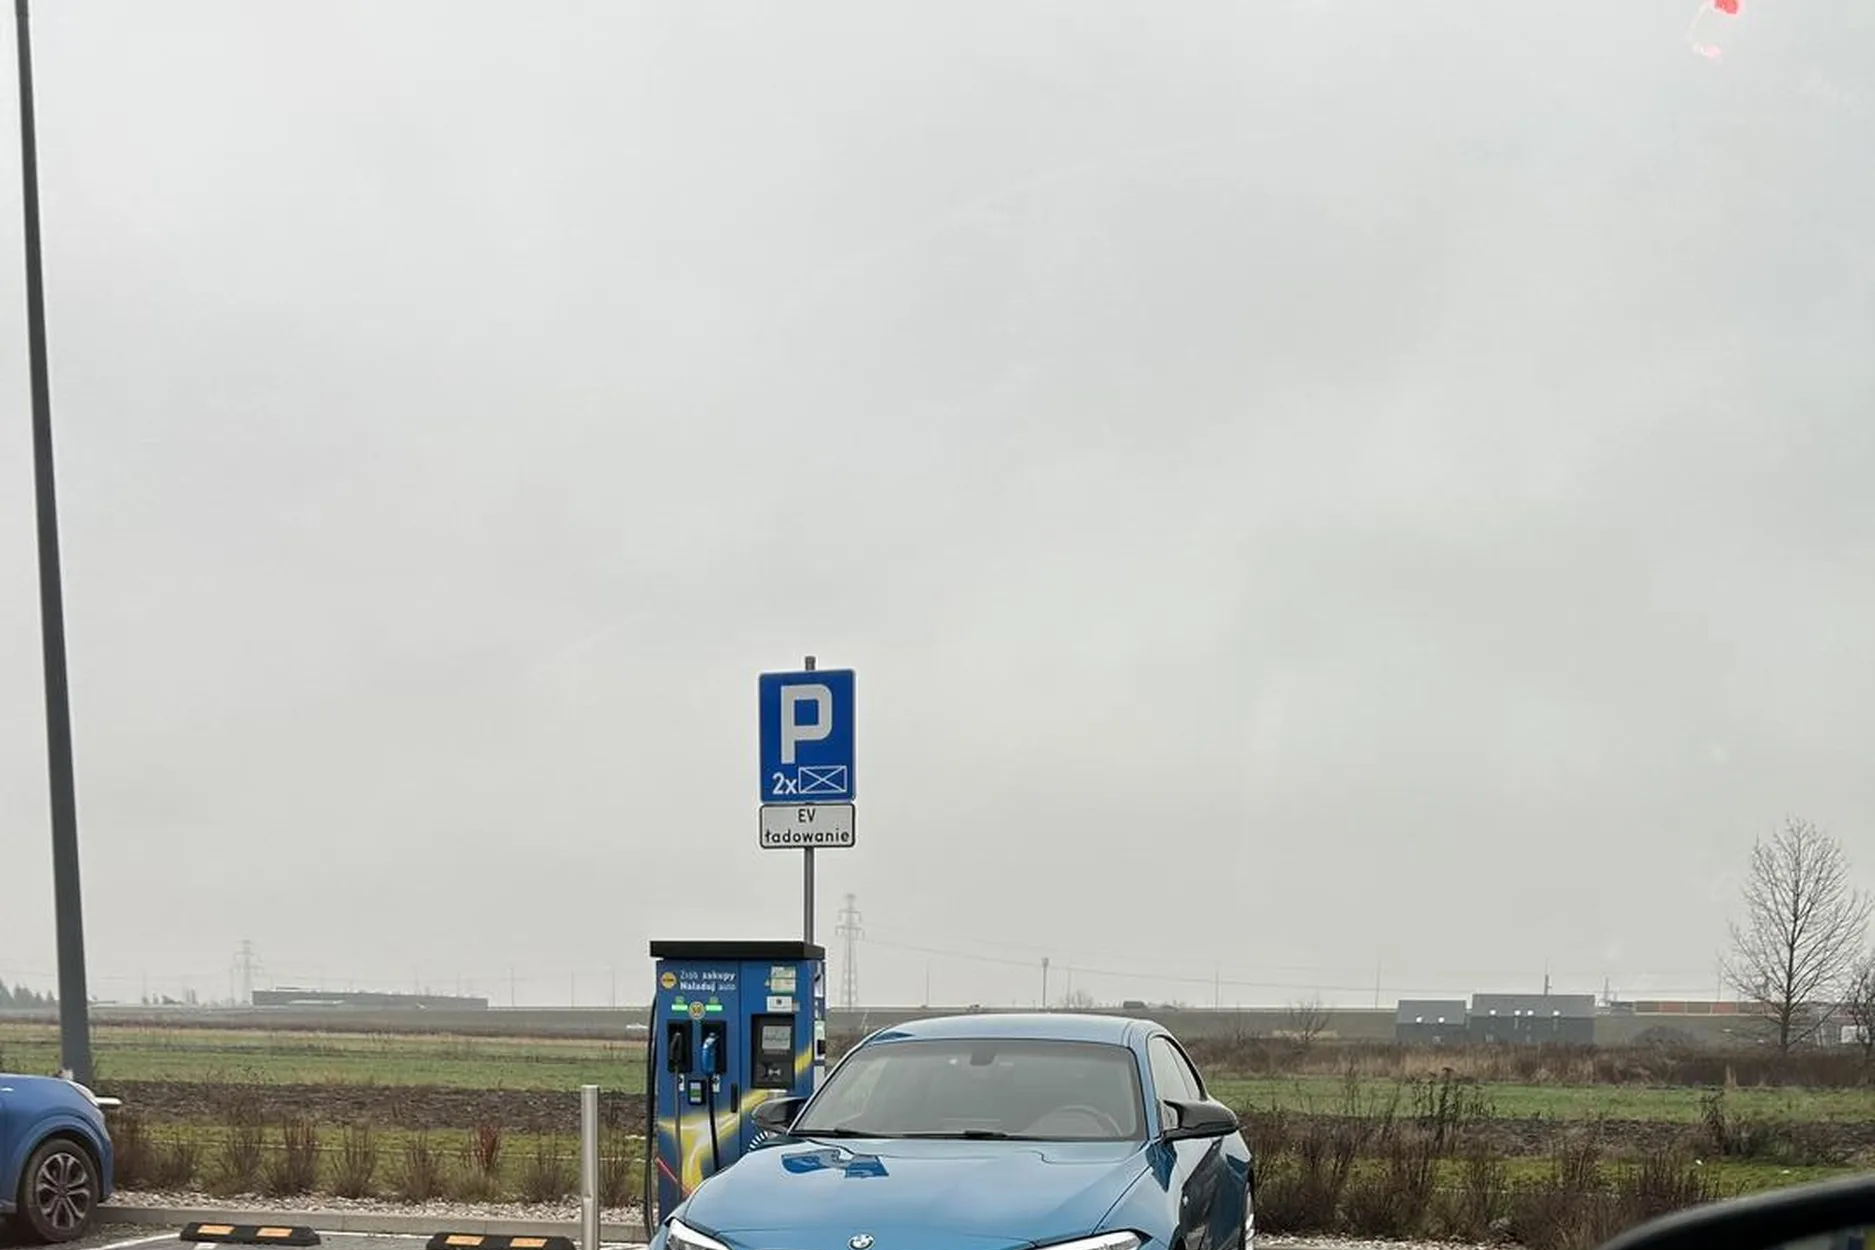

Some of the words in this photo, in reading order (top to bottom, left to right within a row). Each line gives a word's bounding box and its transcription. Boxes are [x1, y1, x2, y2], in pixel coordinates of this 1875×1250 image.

[780, 683, 832, 764] P
[772, 771, 798, 795] 2x
[798, 808, 816, 823] EV
[765, 827, 850, 844] ładowanie
